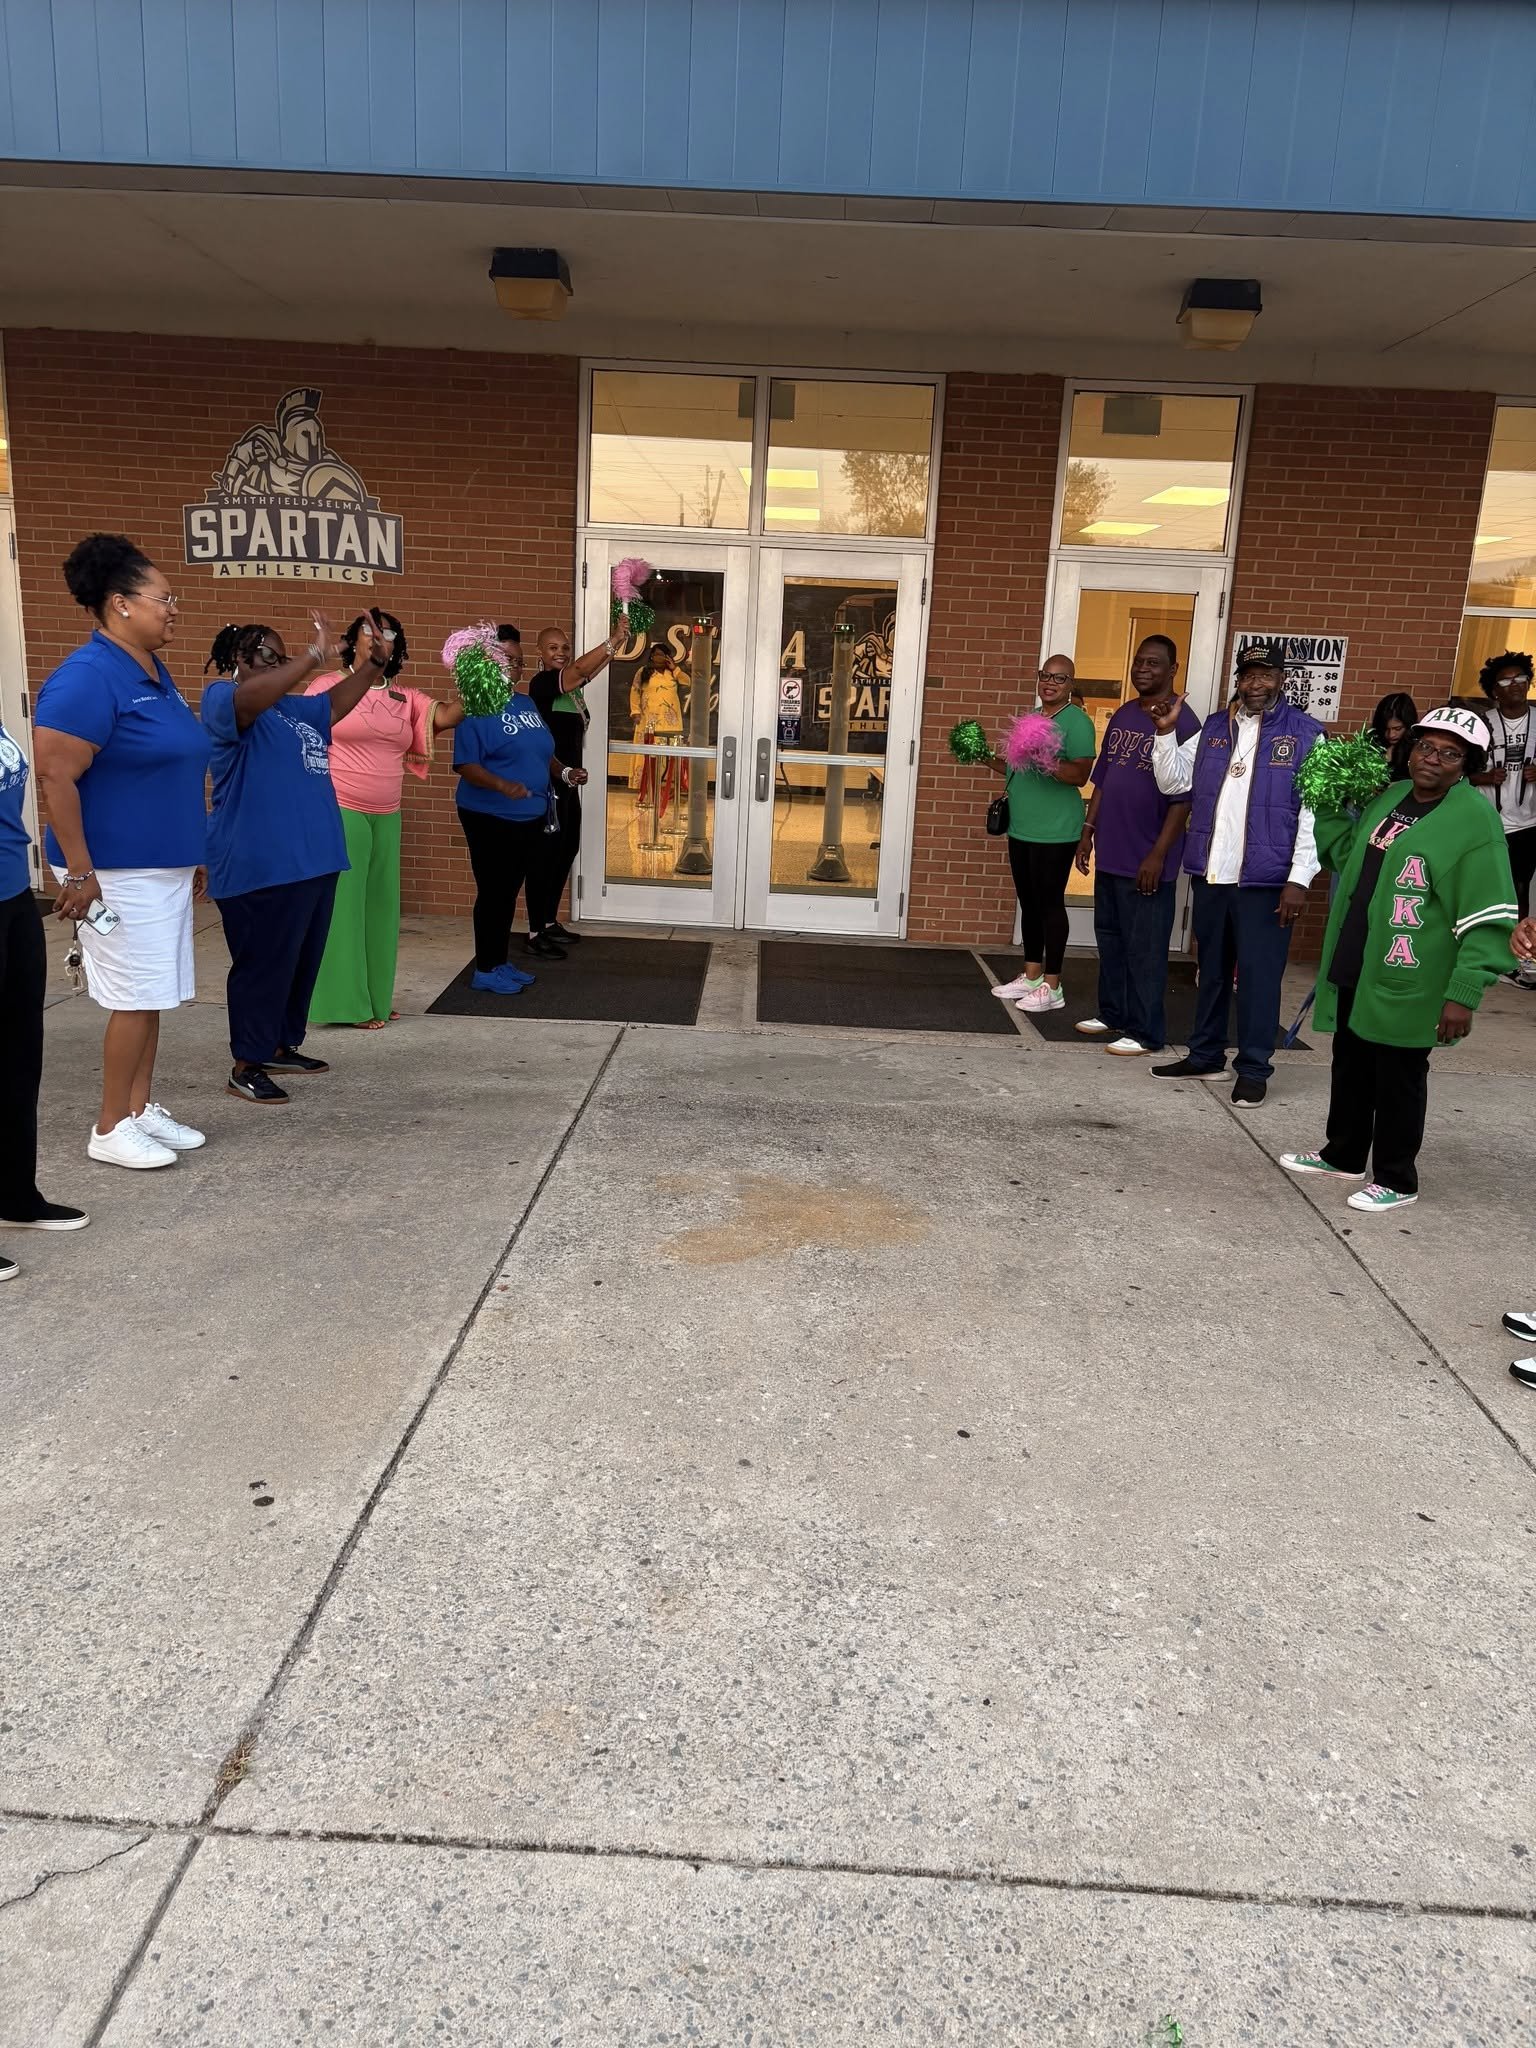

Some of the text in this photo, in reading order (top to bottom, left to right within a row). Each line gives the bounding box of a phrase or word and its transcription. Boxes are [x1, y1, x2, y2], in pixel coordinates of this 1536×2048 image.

[223, 495, 363, 513] SMITHFIELD-SELMA
[190, 508, 398, 569] SPARTAN
[219, 563, 370, 583] ATHLETICS
[1324, 672, 1338, 681] $8
[1323, 685, 1337, 694] $8
[1318, 697, 1332, 706] $8
[1427, 709, 1478, 735] AKA
